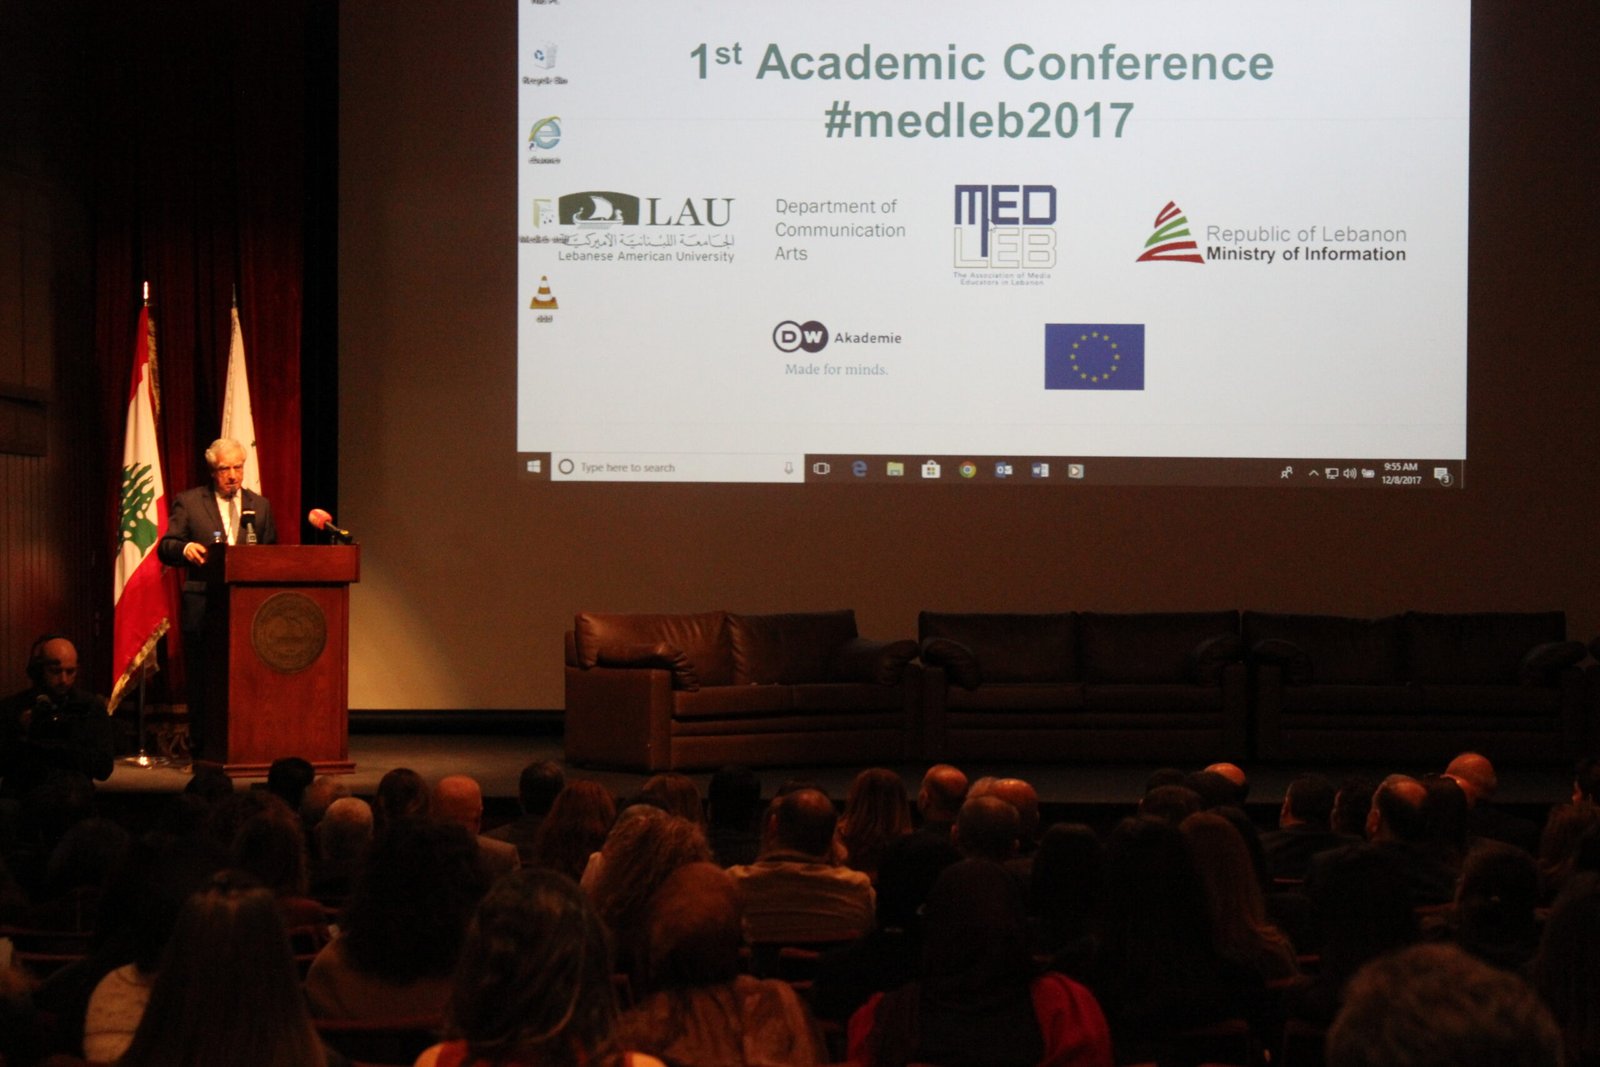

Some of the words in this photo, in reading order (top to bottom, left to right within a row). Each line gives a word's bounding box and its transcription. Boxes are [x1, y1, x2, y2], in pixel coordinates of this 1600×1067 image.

[690, 42, 743, 80] 1st
[756, 43, 986, 80] Academic
[1003, 43, 1274, 81] Conference
[824, 100, 1134, 138] #medleb2017
[645, 197, 736, 227] LAU
[775, 198, 876, 216] Department
[881, 198, 898, 214] of
[954, 184, 1057, 258] MED
[775, 222, 906, 238] Communication
[1206, 225, 1290, 245] Republic
[1297, 225, 1315, 242] of
[1322, 226, 1407, 243] Lebanon
[775, 246, 808, 261] Arts
[954, 227, 1057, 268] LEB
[1206, 246, 1276, 264] Ministry
[1282, 247, 1300, 261] of
[1305, 247, 1406, 261] Information
[558, 251, 613, 261] Lebanese
[618, 251, 672, 261] American
[676, 251, 735, 263] University
[781, 330, 823, 344] DW
[834, 332, 902, 344] Akademie
[785, 363, 820, 376] Made
[823, 363, 842, 375] for
[845, 363, 889, 376] minds.
[581, 462, 604, 473] Type
[606, 462, 629, 472] here
[631, 463, 642, 472] to
[644, 462, 676, 473] search
[1384, 462, 1401, 471] 9:55
[1403, 463, 1418, 471] AM
[1382, 476, 1422, 485] 12/8/2017
